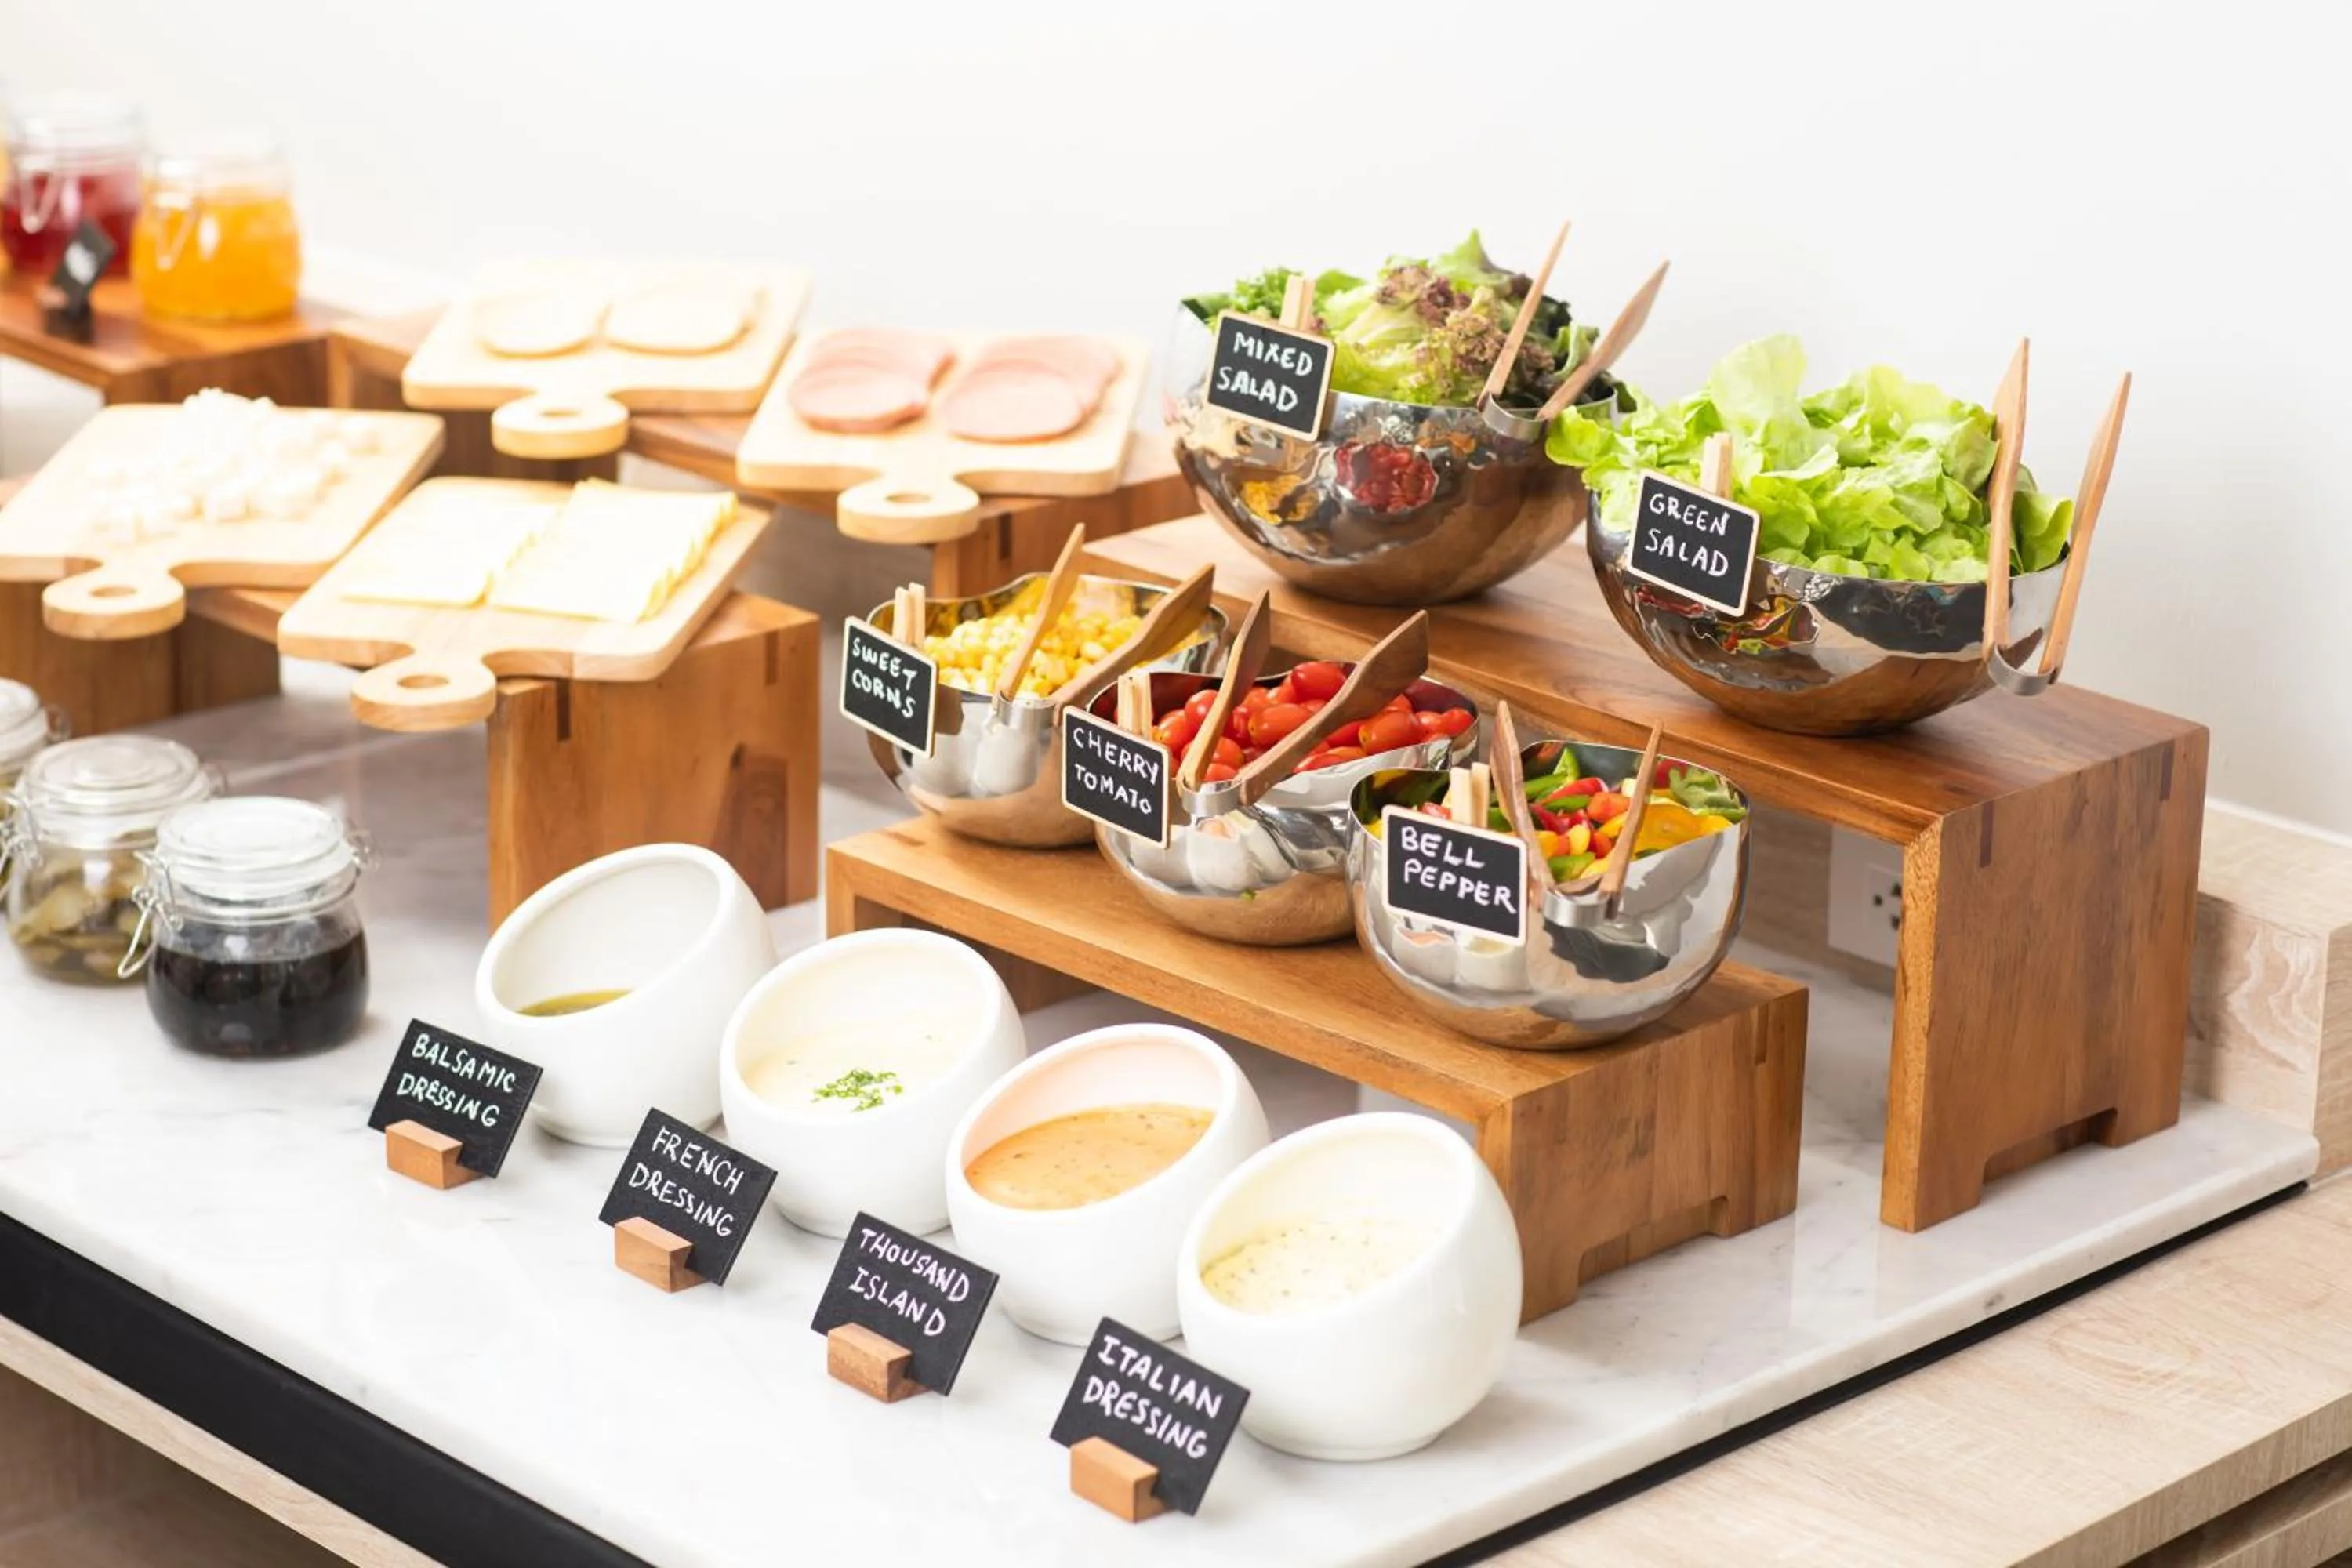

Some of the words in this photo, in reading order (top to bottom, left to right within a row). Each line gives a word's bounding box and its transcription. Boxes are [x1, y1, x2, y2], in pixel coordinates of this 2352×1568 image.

[1232, 332, 1313, 376] MIXED
[1216, 367, 1299, 412] SALAD
[1649, 493, 1730, 536] GREEN
[1644, 528, 1730, 578] SALAD
[852, 637, 919, 691] SWEET
[851, 668, 917, 719] CORNS
[1073, 727, 1160, 786] CHERRY
[1075, 764, 1152, 815] TOMATO
[1400, 826, 1486, 869] BELL
[1403, 860, 1517, 915] PEPPER
[412, 1033, 517, 1094] BALSAMIC
[396, 1074, 501, 1128] DRESSING
[651, 1127, 744, 1195] FRENCH
[629, 1166, 735, 1238] DRESSING
[858, 1227, 971, 1302] THOUSAND
[848, 1266, 946, 1338] ISLAND
[1096, 1334, 1223, 1419] ITALIAN
[1081, 1376, 1209, 1457] DRESSING
